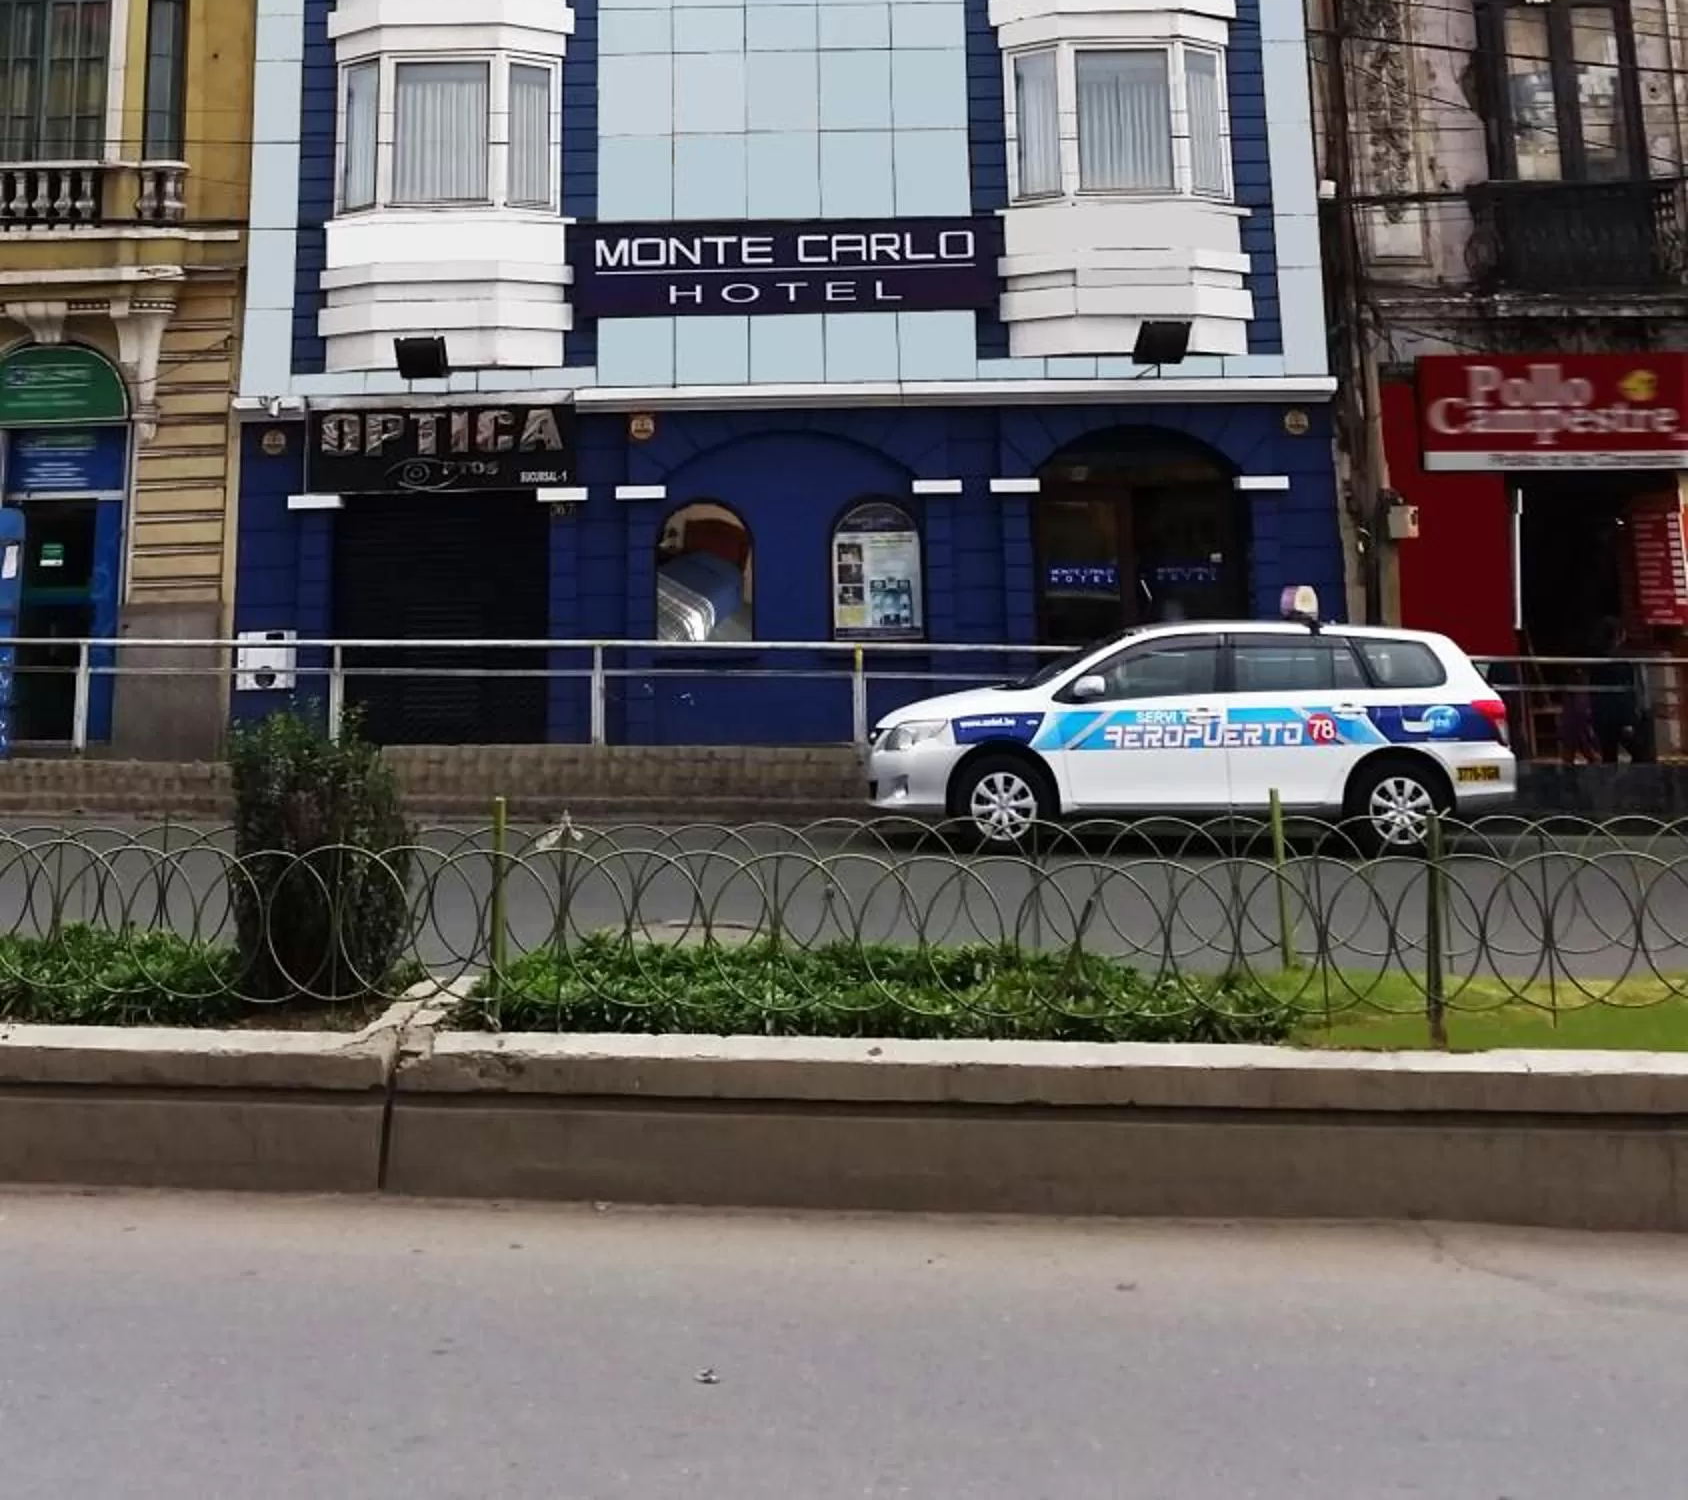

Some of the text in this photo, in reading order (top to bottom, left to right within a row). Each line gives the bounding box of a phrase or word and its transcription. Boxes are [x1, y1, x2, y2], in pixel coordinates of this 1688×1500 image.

[596, 231, 974, 267] MONTE CARLO
[669, 280, 903, 304] HOTEL
[1464, 364, 1594, 406] Pollo
[321, 408, 562, 455] OPTICA
[1428, 398, 1680, 444] Campestre
[1136, 710, 1180, 724] SERVI
[1310, 719, 1335, 740] 78
[1104, 722, 1303, 748] AEROPUERTO
